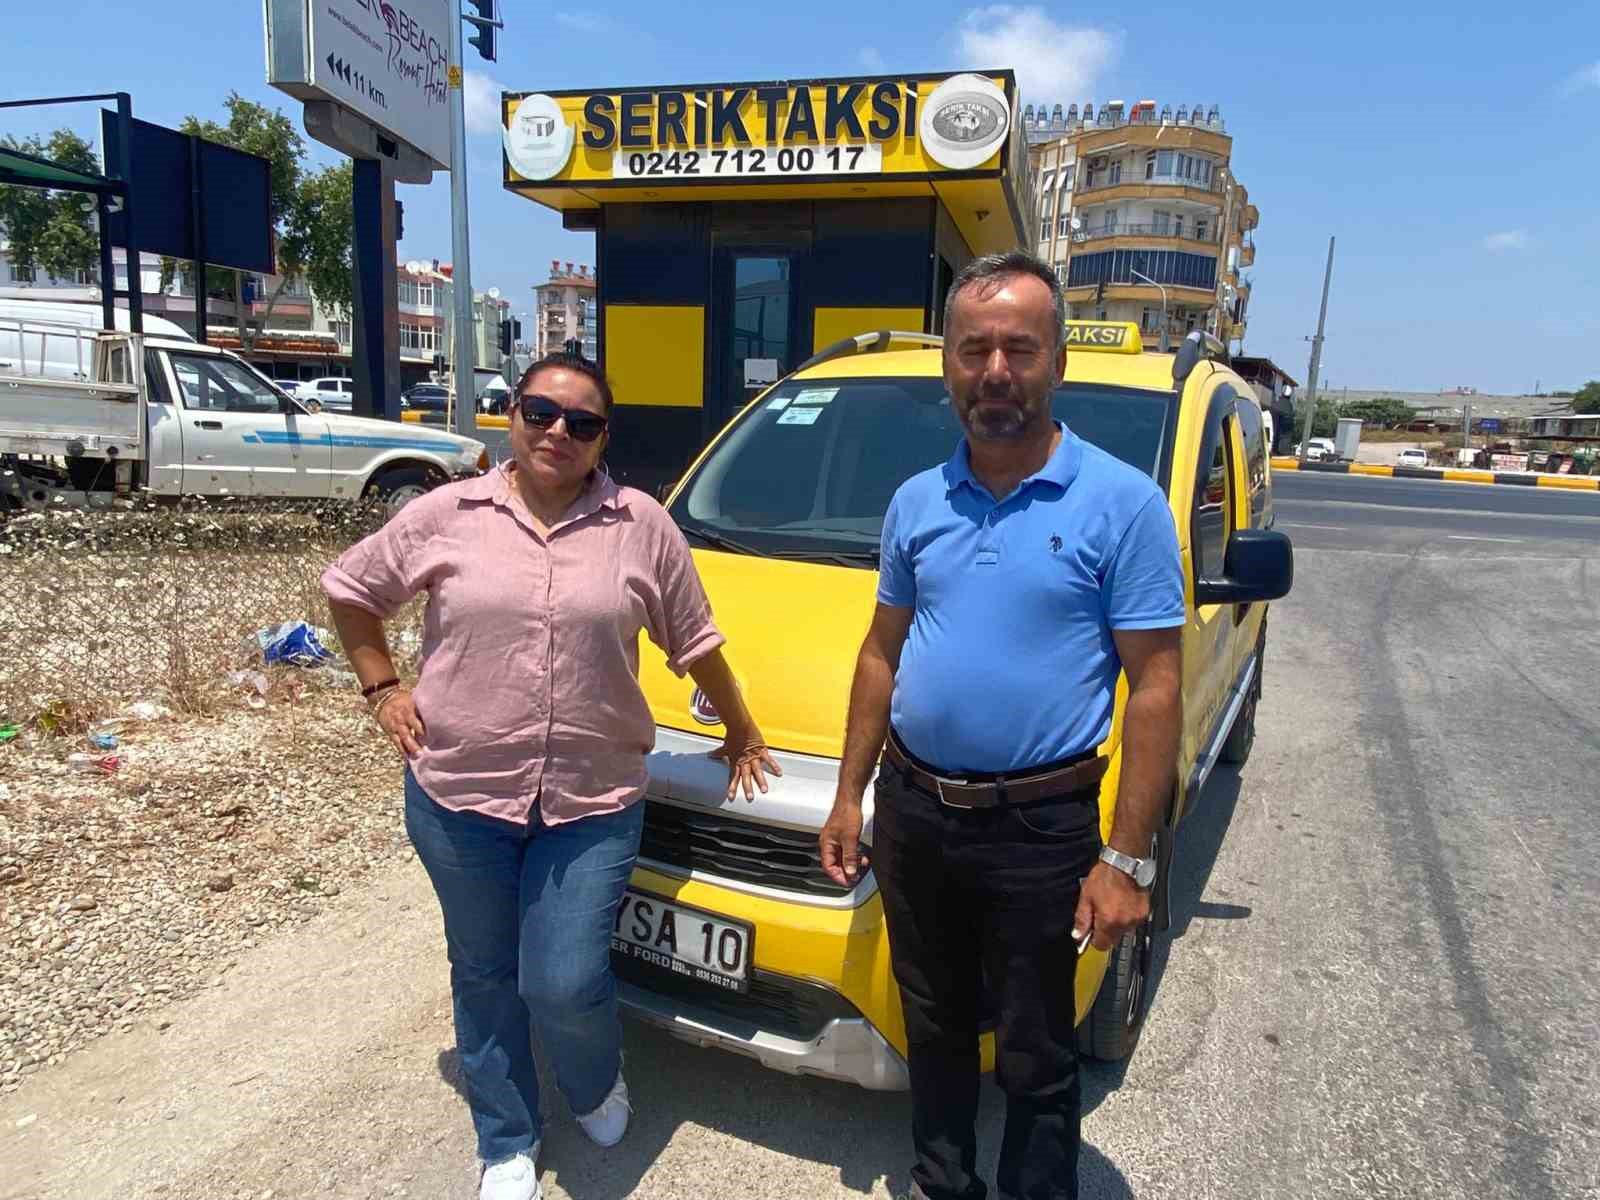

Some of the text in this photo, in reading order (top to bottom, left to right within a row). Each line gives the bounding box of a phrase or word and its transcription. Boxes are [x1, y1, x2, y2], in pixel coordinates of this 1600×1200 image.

[399, 9, 448, 76] BEACH
[353, 71, 388, 110] 11 km.
[424, 60, 448, 108] Hotel
[628, 146, 864, 176] 0242 712 00 17
[1065, 327, 1126, 344] AKSI
[633, 946, 671, 968] FORD
[701, 921, 743, 972] 10
